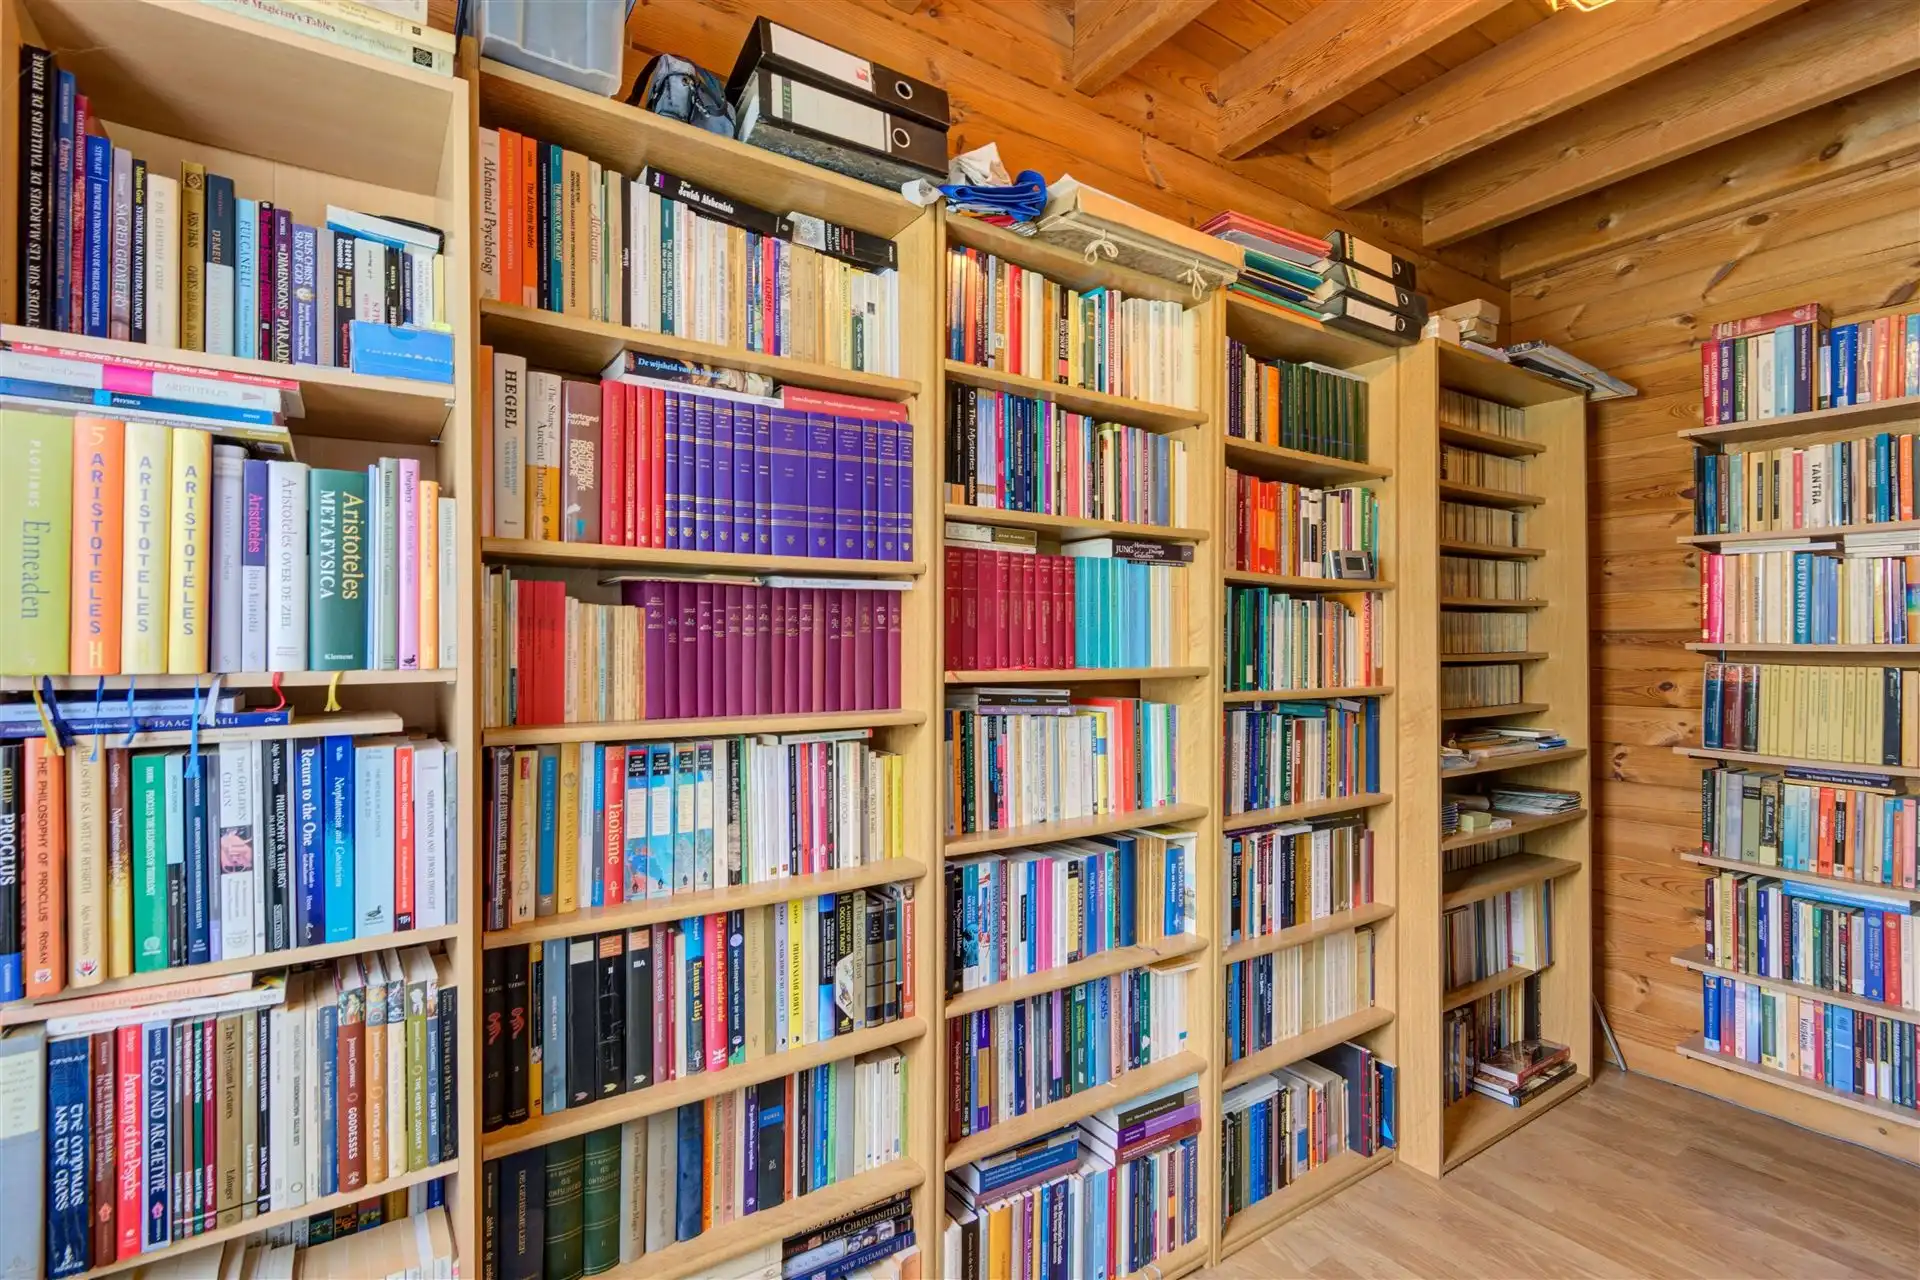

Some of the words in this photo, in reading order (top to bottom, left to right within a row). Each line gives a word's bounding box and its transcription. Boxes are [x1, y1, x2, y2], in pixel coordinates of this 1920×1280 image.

[32, 54, 45, 91] PIERRE
[31, 93, 45, 109] DE
[31, 110, 44, 167] TAILLEURS
[30, 170, 43, 186] DE
[484, 157, 497, 214] Alchemical
[526, 183, 536, 196] The
[29, 188, 43, 240] MARQUES
[525, 197, 536, 226] Alchemy
[678, 186, 701, 202] Jewish
[700, 193, 734, 215] Alchemists
[29, 242, 42, 261] LES
[480, 219, 496, 277] Psychology
[526, 226, 536, 249] Reader
[29, 265, 42, 286] SUR
[277, 252, 290, 310] DIMENSIONS
[294, 262, 305, 285] GOD
[666, 251, 674, 288] ALCHEMICAL
[666, 289, 674, 320] TRADITION
[765, 277, 773, 313] ALCHEMY
[638, 357, 648, 367] De
[649, 358, 678, 372] wijsheid
[504, 369, 518, 429] HEGEL
[547, 386, 557, 401] The
[967, 391, 977, 406] On
[546, 403, 557, 428] Shape
[567, 411, 599, 424] bertrand
[967, 409, 977, 428] The
[536, 421, 548, 460] Ancient
[966, 430, 977, 471] Mysteries
[569, 438, 579, 477] FILOSOFIE
[534, 464, 548, 508] Thought
[1812, 462, 1822, 506] TANTRA
[248, 493, 264, 554] Aristoteles
[280, 477, 298, 549] Aristoteles
[90, 452, 105, 636] ARISTOTELES
[136, 456, 152, 633] ARISTOTELES
[184, 465, 198, 636] ARISTOTELES
[320, 490, 336, 601] METAFYSICA
[342, 491, 364, 601] Aristoteles
[1115, 545, 1134, 555] JUNG
[21, 520, 51, 620] Enneaden
[280, 552, 293, 583] OVER
[1797, 559, 1806, 571] DE
[280, 586, 293, 603] DE
[1797, 573, 1806, 635] UPANISHADS
[280, 605, 293, 630] ZIEL
[154, 718, 190, 729] ISAAC
[38, 756, 49, 776] THE
[302, 748, 316, 788] Return
[302, 789, 316, 801] to
[37, 781, 49, 848] PHILOSOPHY
[302, 803, 316, 821] the
[302, 822, 316, 846] One
[607, 799, 623, 865] Taoïsme
[0, 813, 15, 886] PROCLUS
[38, 853, 49, 867] OF
[38, 872, 49, 922] PROCLUS
[857, 906, 866, 921] The
[716, 928, 726, 950] Tarot
[857, 924, 866, 956] Esoteric
[692, 961, 704, 997] Enuma
[716, 960, 726, 970] de
[692, 1000, 704, 1022] elisj
[1101, 976, 1110, 1020] GNOSIS
[224, 1026, 237, 1041] The
[150, 1059, 166, 1086] EGO
[224, 1043, 237, 1085] Mysterium
[121, 1073, 140, 1124] Anatomy
[150, 1089, 166, 1119] AND
[224, 1086, 237, 1120] Lectures
[348, 1107, 358, 1159] GODDESSES
[150, 1123, 166, 1195] ARCHETYPE
[121, 1159, 140, 1200] Psyche
[518, 1170, 526, 1183] DE
[518, 1184, 526, 1230] GEHEIME
[822, 1228, 842, 1242] LOST
[842, 1203, 901, 1234] CHRISTIANITIES
[518, 1232, 526, 1256] LEER
[840, 1260, 856, 1273] NEW
[857, 1245, 894, 1266] TESTAMENT
